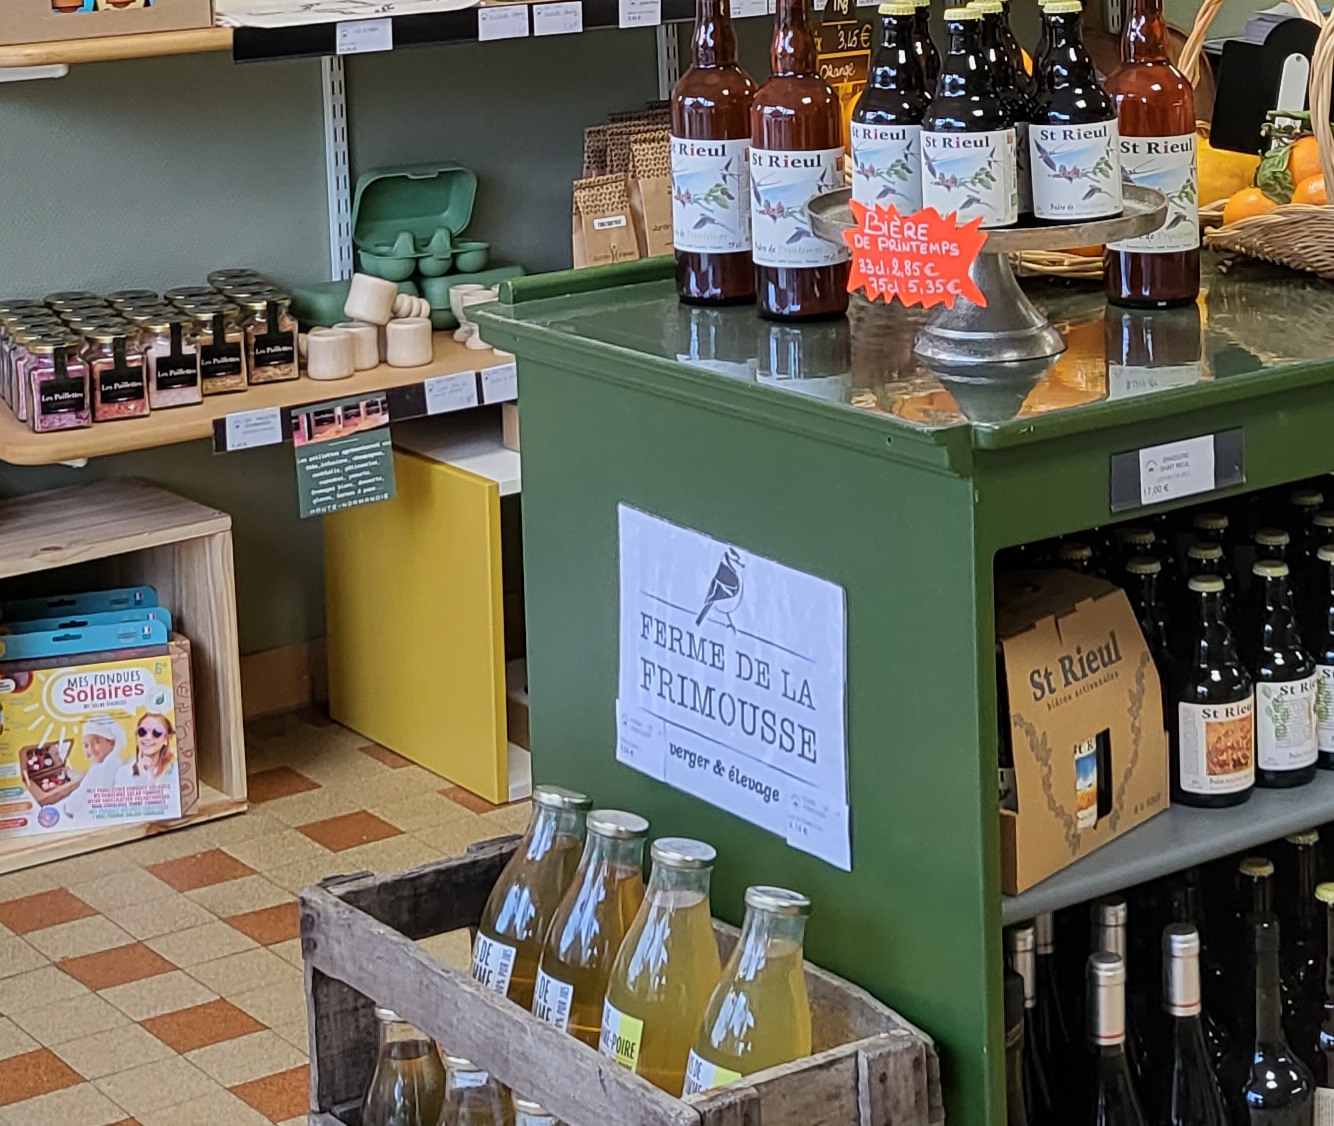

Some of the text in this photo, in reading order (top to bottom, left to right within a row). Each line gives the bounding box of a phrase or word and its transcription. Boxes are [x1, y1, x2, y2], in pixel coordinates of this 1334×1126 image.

[863, 129, 906, 140] Rieul
[1040, 125, 1108, 141] St Rieul
[925, 136, 989, 148] St Rieul
[1120, 138, 1193, 154] St Rieul
[679, 143, 726, 157] Rieul
[753, 153, 822, 168] St Rieul
[854, 235, 870, 250] DE
[256, 344, 293, 354] Les Paillettes
[201, 355, 240, 366] Les Paillettes
[157, 367, 197, 378] Les Paillettes
[101, 380, 142, 392] Les Paillettes
[41, 391, 84, 403] Les Paillettes
[640, 612, 817, 711] FERME DE LA
[1029, 629, 1122, 702] St Rieul
[68, 675, 88, 689] MES
[63, 683, 145, 704] Solaires
[1280, 685, 1296, 695] St
[640, 656, 818, 764] FRIMOUSSE
[1202, 707, 1218, 719] St
[668, 740, 780, 803] verger & élevage
